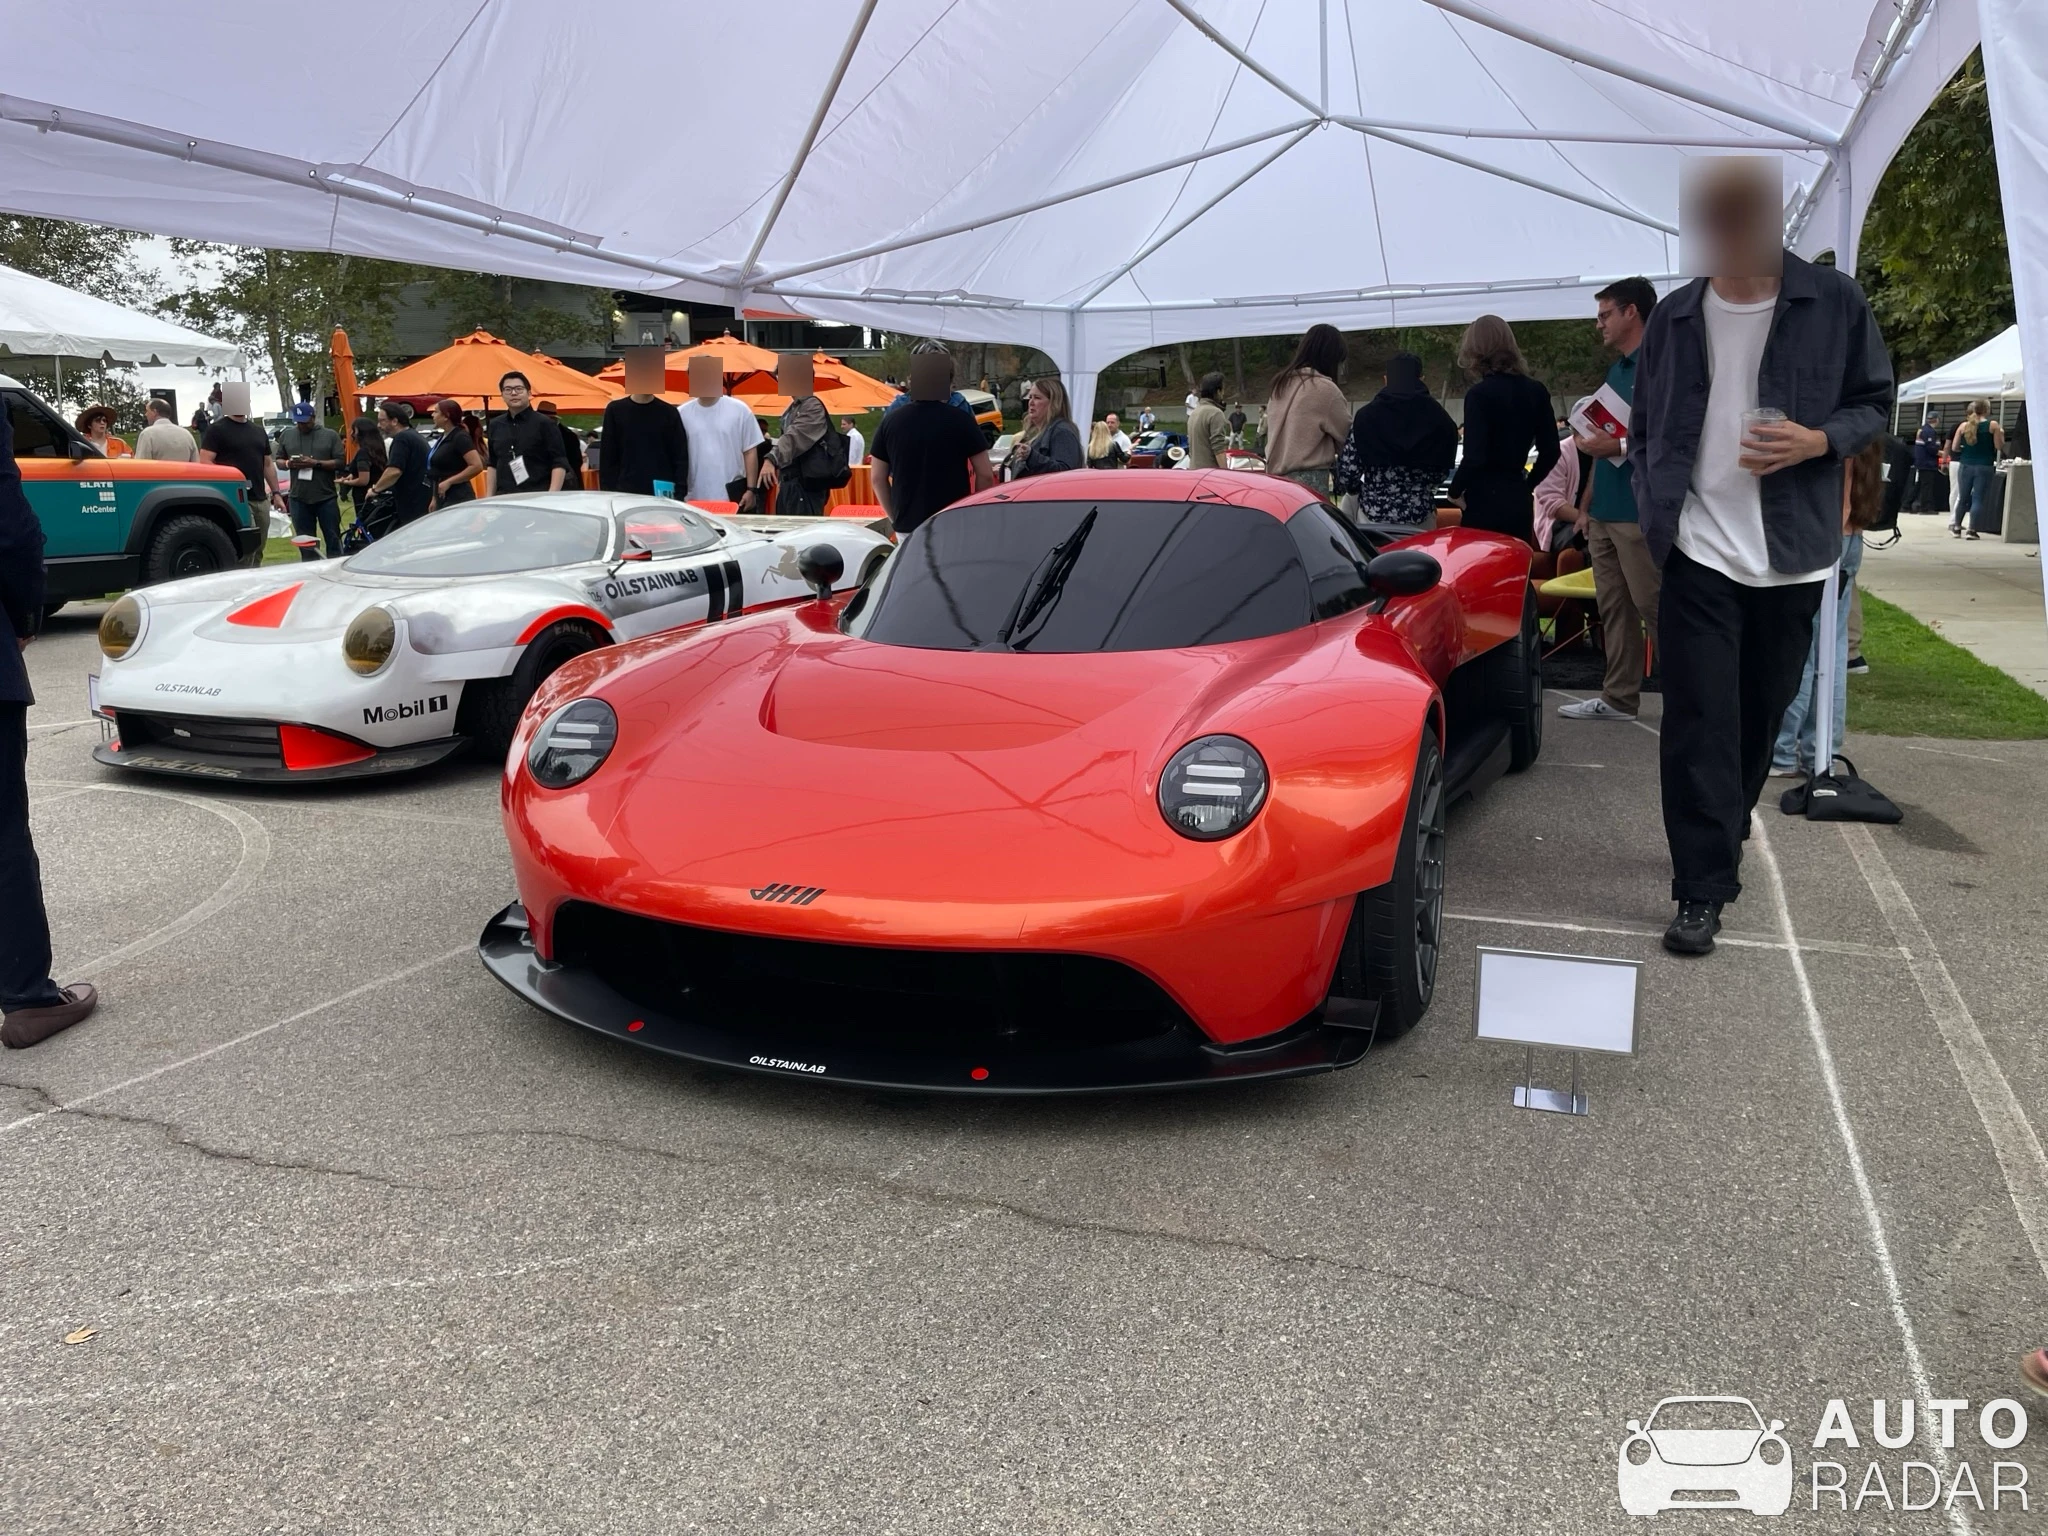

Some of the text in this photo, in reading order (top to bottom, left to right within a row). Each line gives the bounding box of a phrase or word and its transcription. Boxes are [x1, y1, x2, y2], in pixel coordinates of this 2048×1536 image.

[81, 505, 117, 513] ArtCenter
[605, 569, 699, 599] OILSTAINLAB
[155, 683, 222, 696] OILSTAINLAB
[363, 699, 425, 725] Mobil
[749, 1056, 826, 1073] OILSTAINLAB
